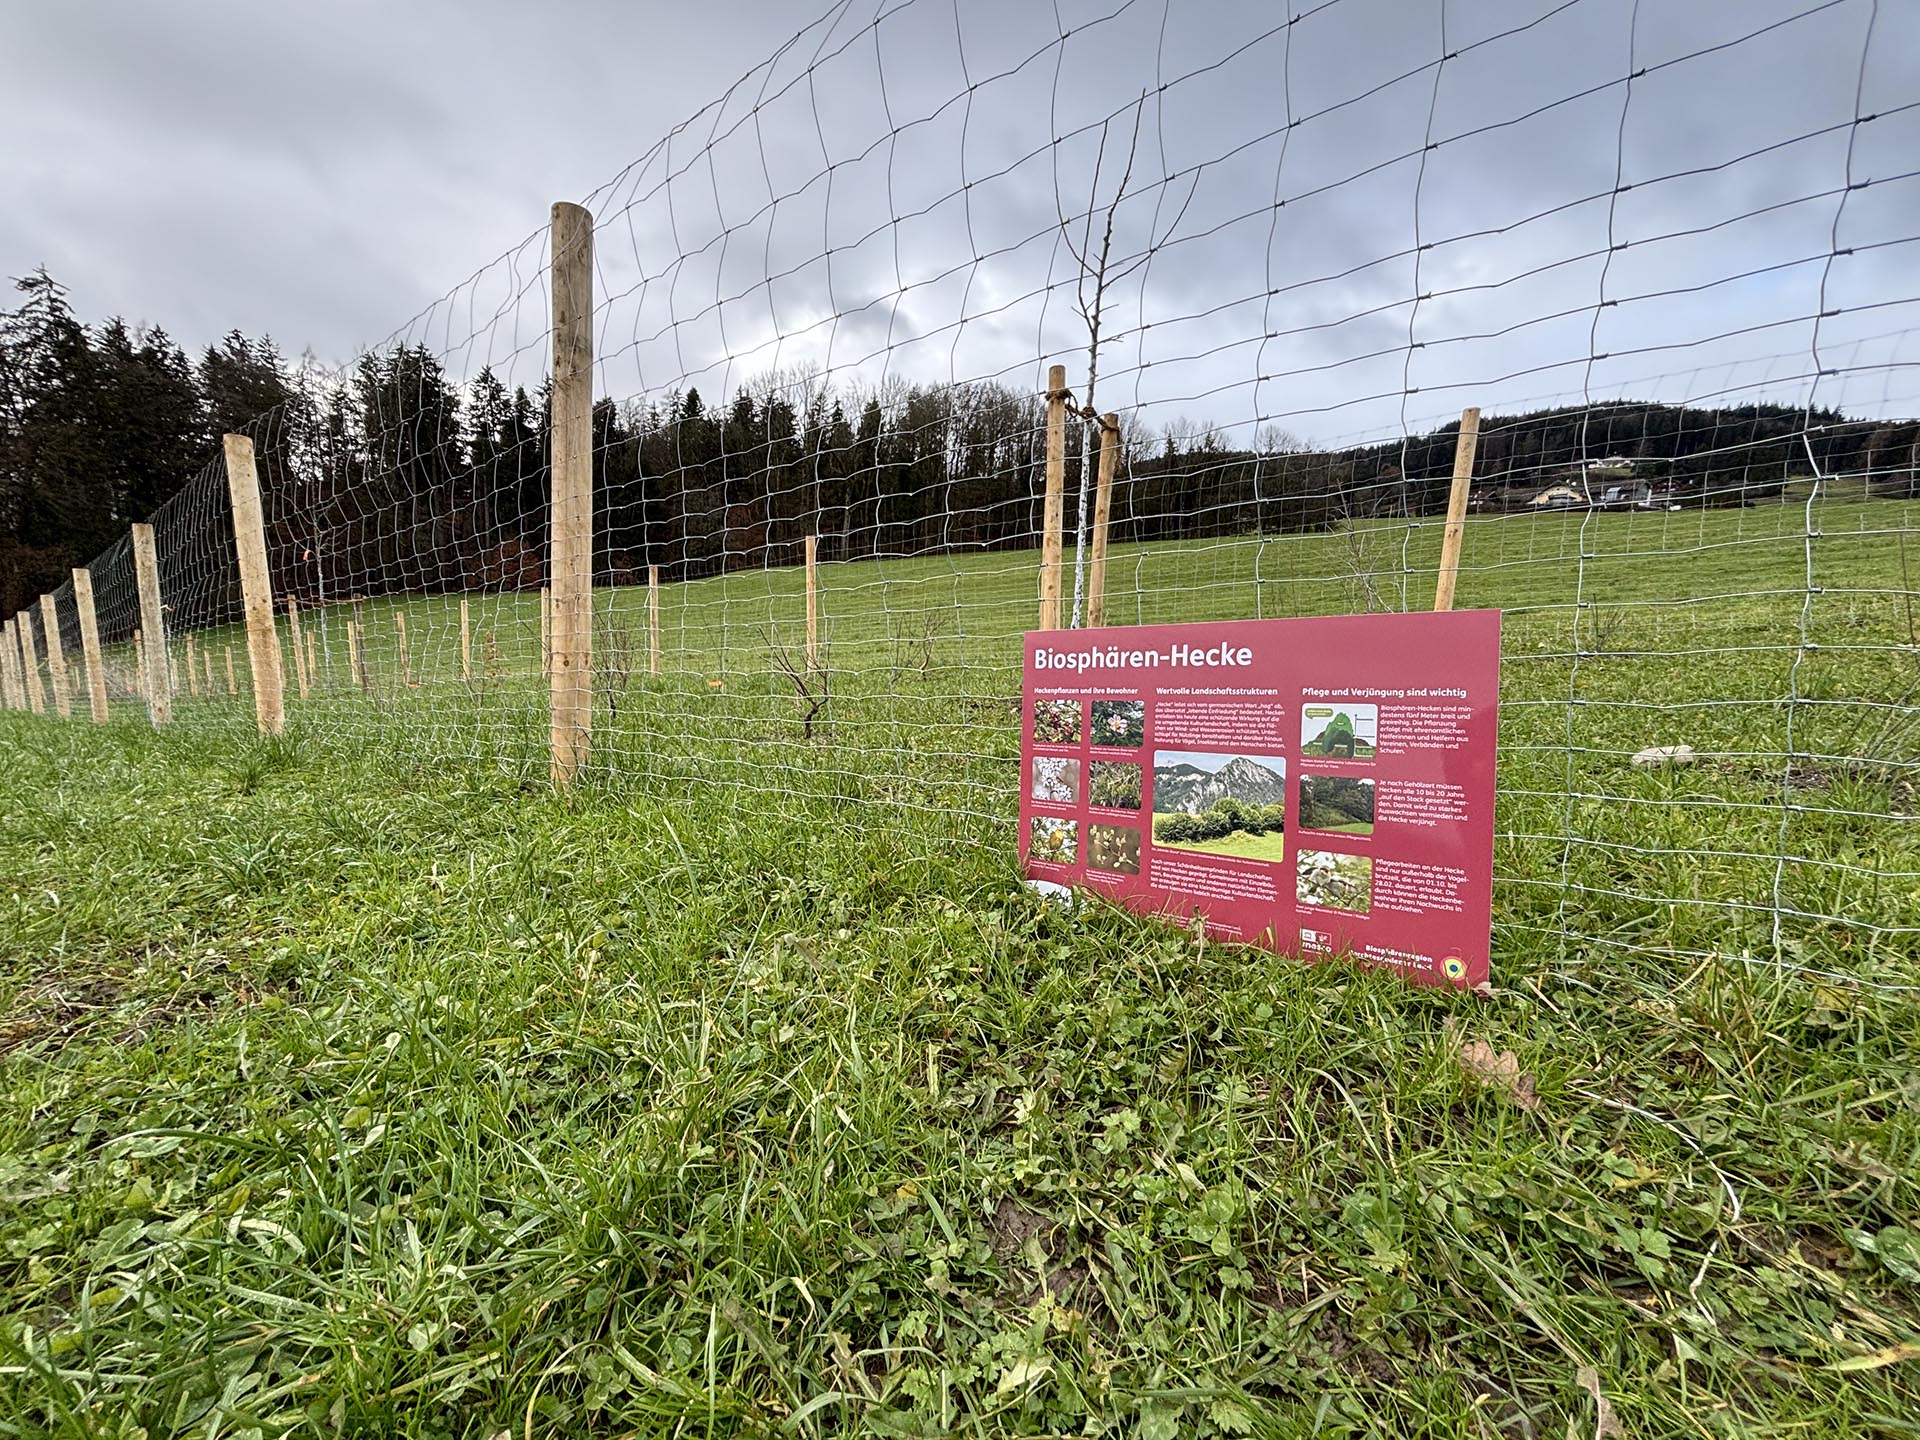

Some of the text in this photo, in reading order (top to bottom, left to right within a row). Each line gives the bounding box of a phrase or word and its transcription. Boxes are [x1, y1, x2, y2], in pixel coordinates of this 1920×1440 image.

[1034, 642, 1252, 674] Biosphären-Hecke
[1302, 688, 1329, 697] Pflege
[1351, 689, 1404, 698] Verjüngung
[1430, 689, 1466, 698] wichtig
[1376, 860, 1421, 869] Pflegearbeiten
[1375, 874, 1400, 882] brutzeit,
[1402, 870, 1434, 878] außerhalb
[1448, 875, 1469, 883] Vogel-
[1395, 883, 1417, 891] dauert,
[1429, 895, 1464, 903] Heckenbe-
[1391, 905, 1423, 913] aufziehen.
[1416, 901, 1454, 910] Nachwuchs
